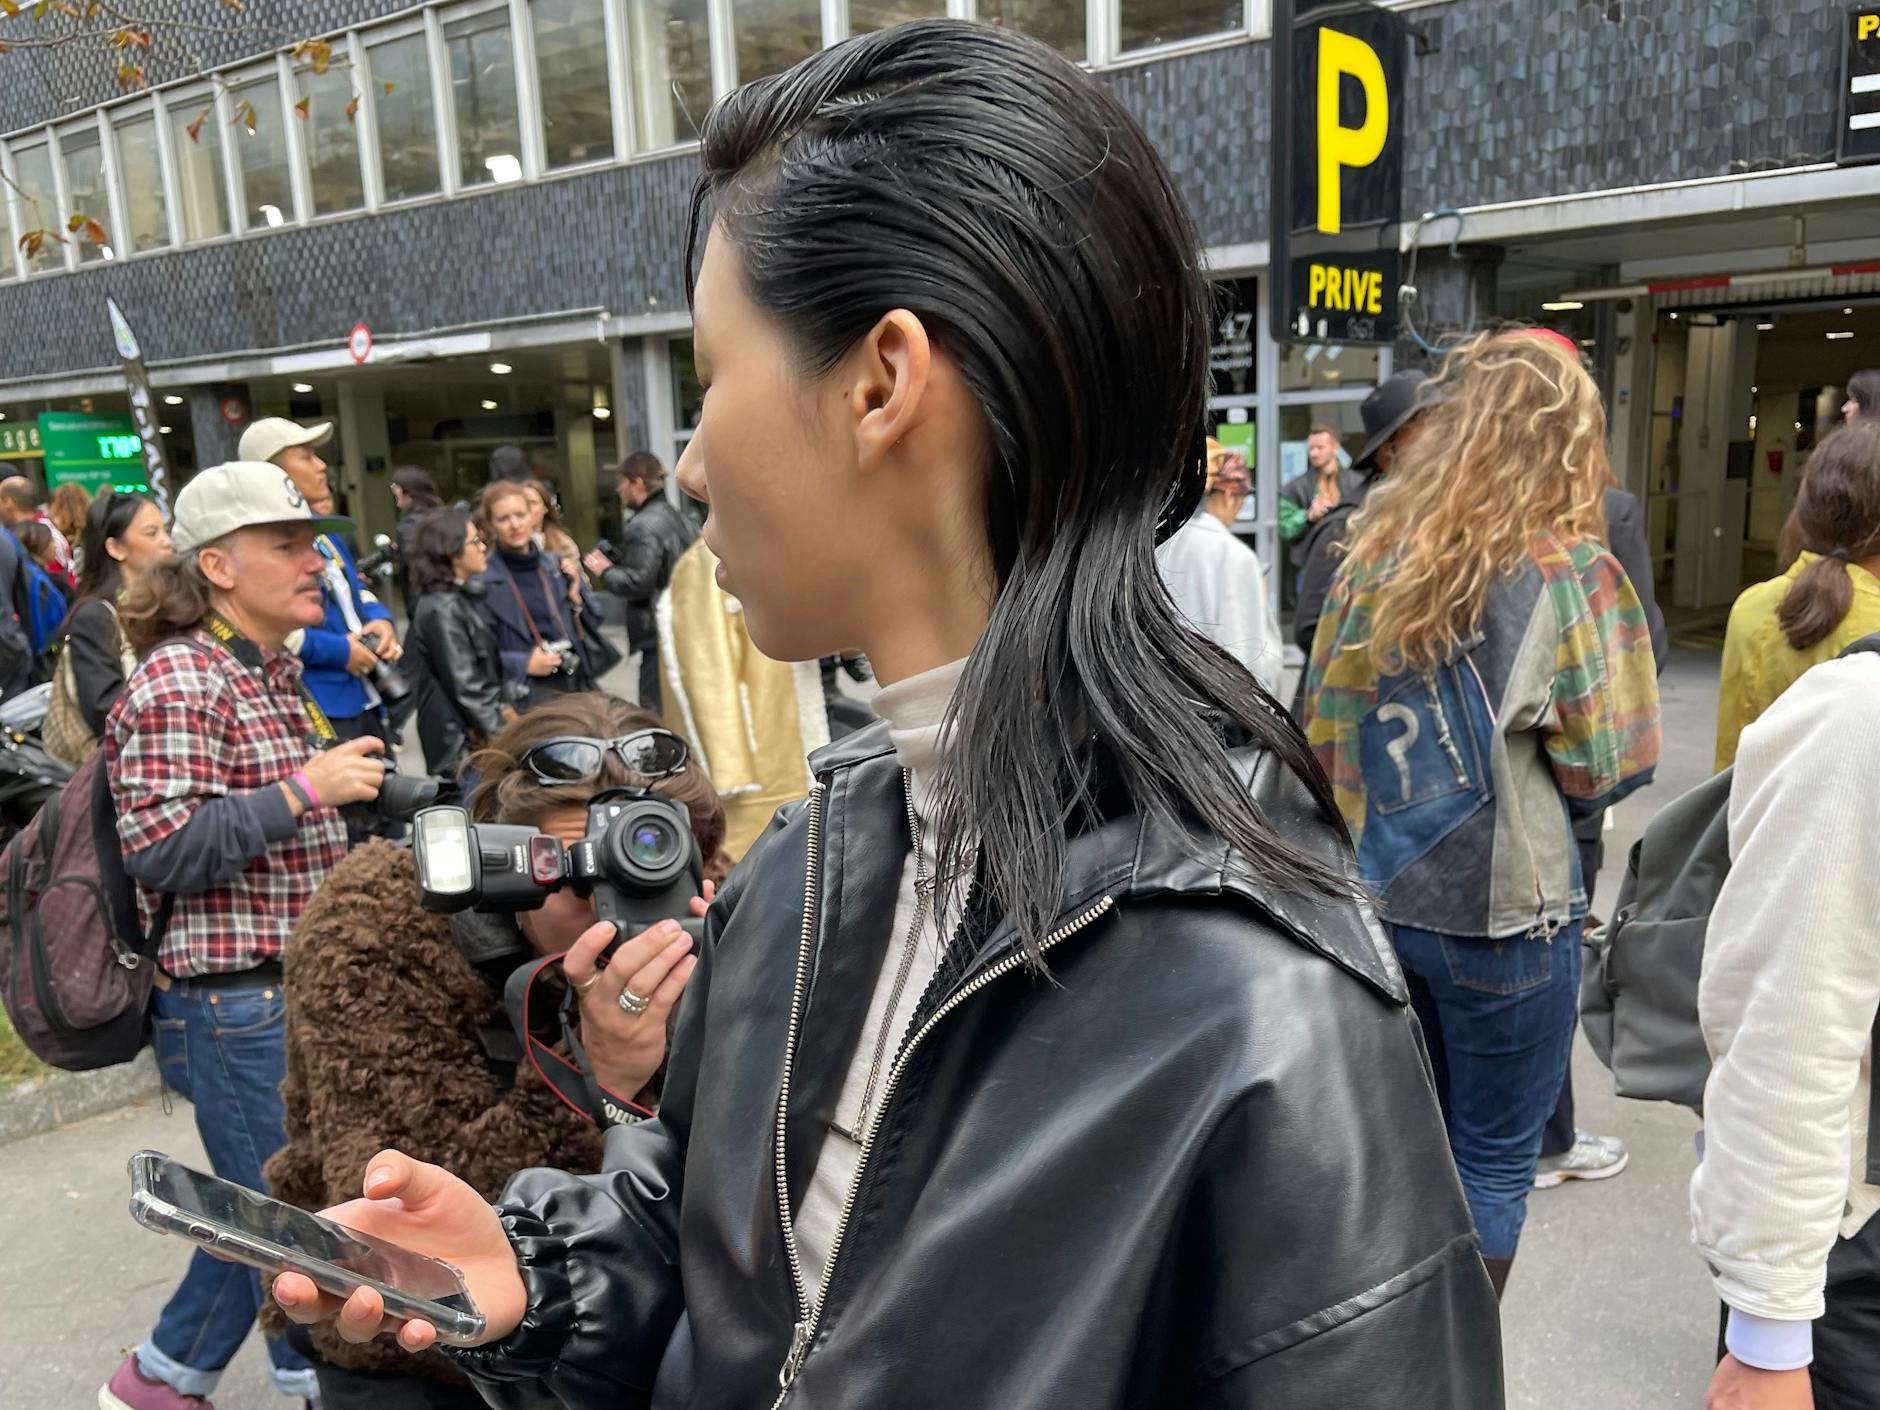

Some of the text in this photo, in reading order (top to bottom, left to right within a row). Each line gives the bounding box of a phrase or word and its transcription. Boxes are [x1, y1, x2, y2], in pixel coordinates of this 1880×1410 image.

[1317, 26, 1389, 233] P
[1310, 264, 1382, 314] PRIVE
[585, 842, 595, 873] Canon
